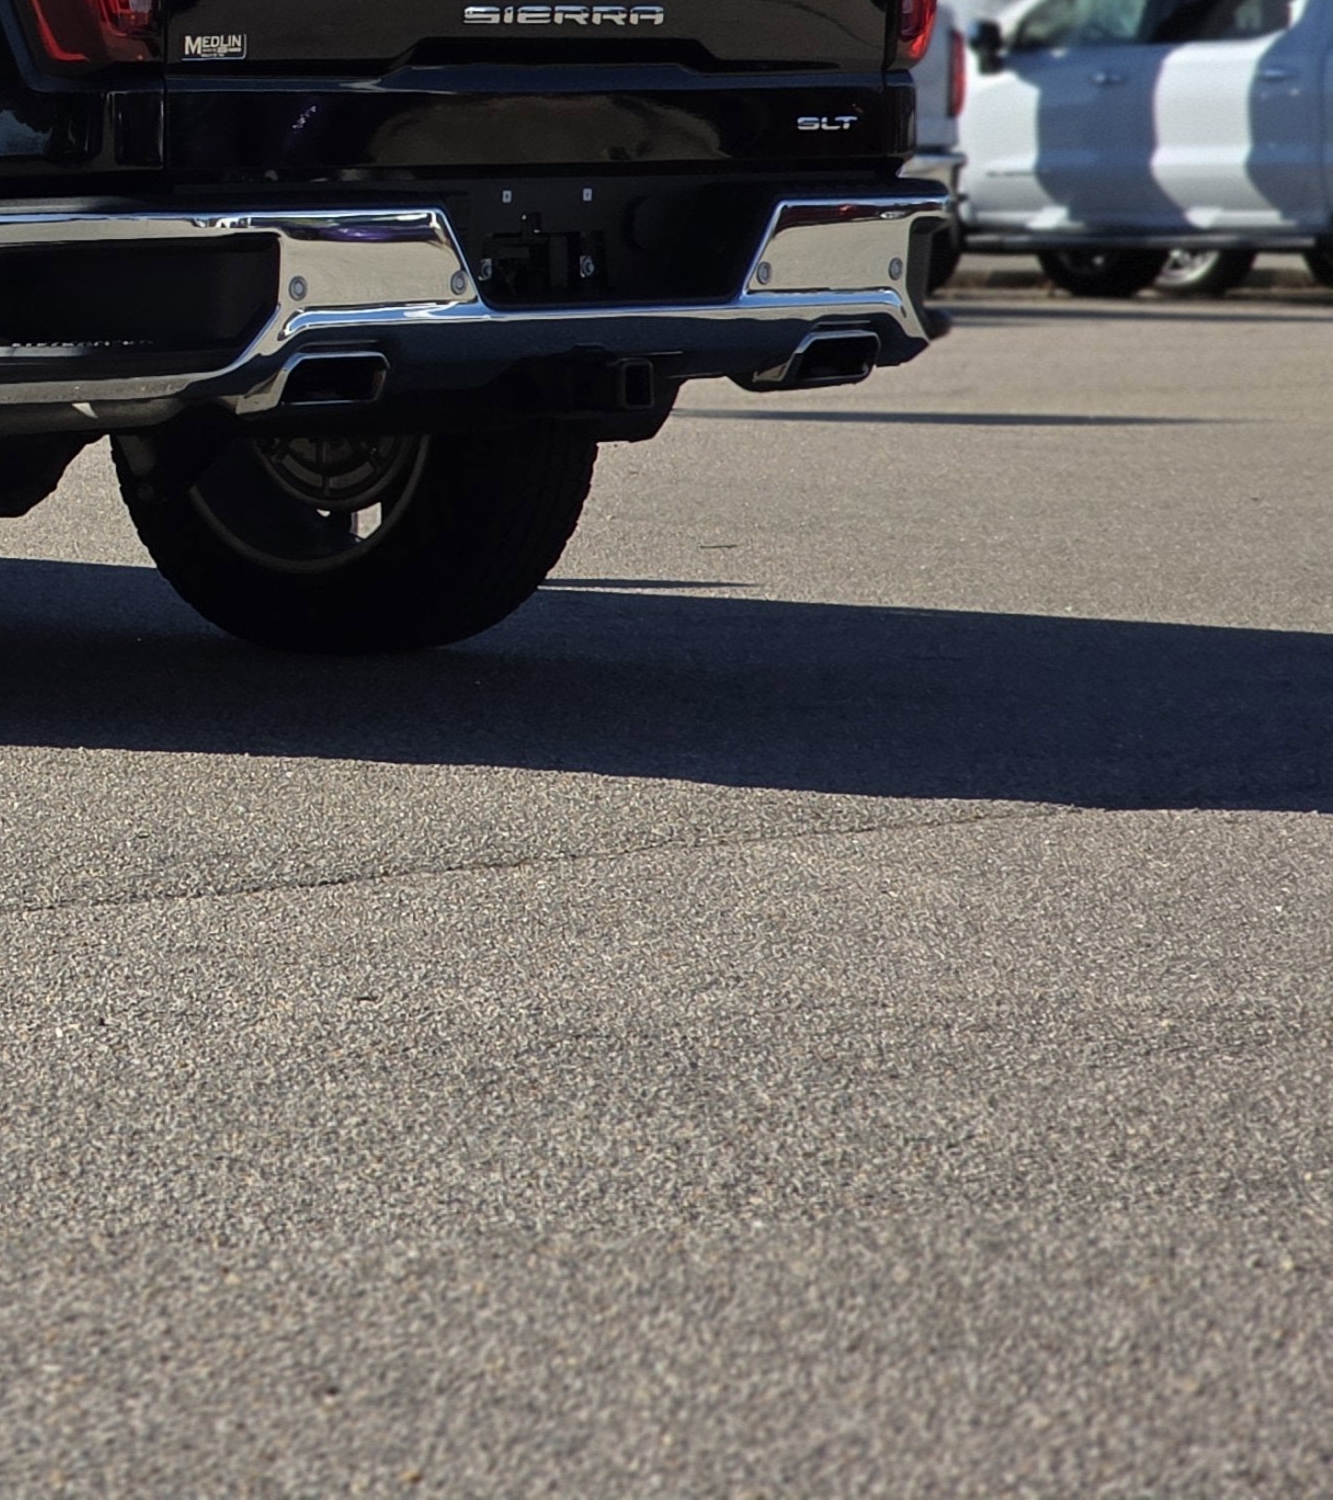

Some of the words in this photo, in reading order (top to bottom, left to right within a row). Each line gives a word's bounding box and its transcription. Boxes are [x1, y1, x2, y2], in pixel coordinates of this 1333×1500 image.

[463, 5, 665, 26] SIERRA
[184, 34, 242, 55] MEDLIN
[797, 116, 858, 131] SLT
